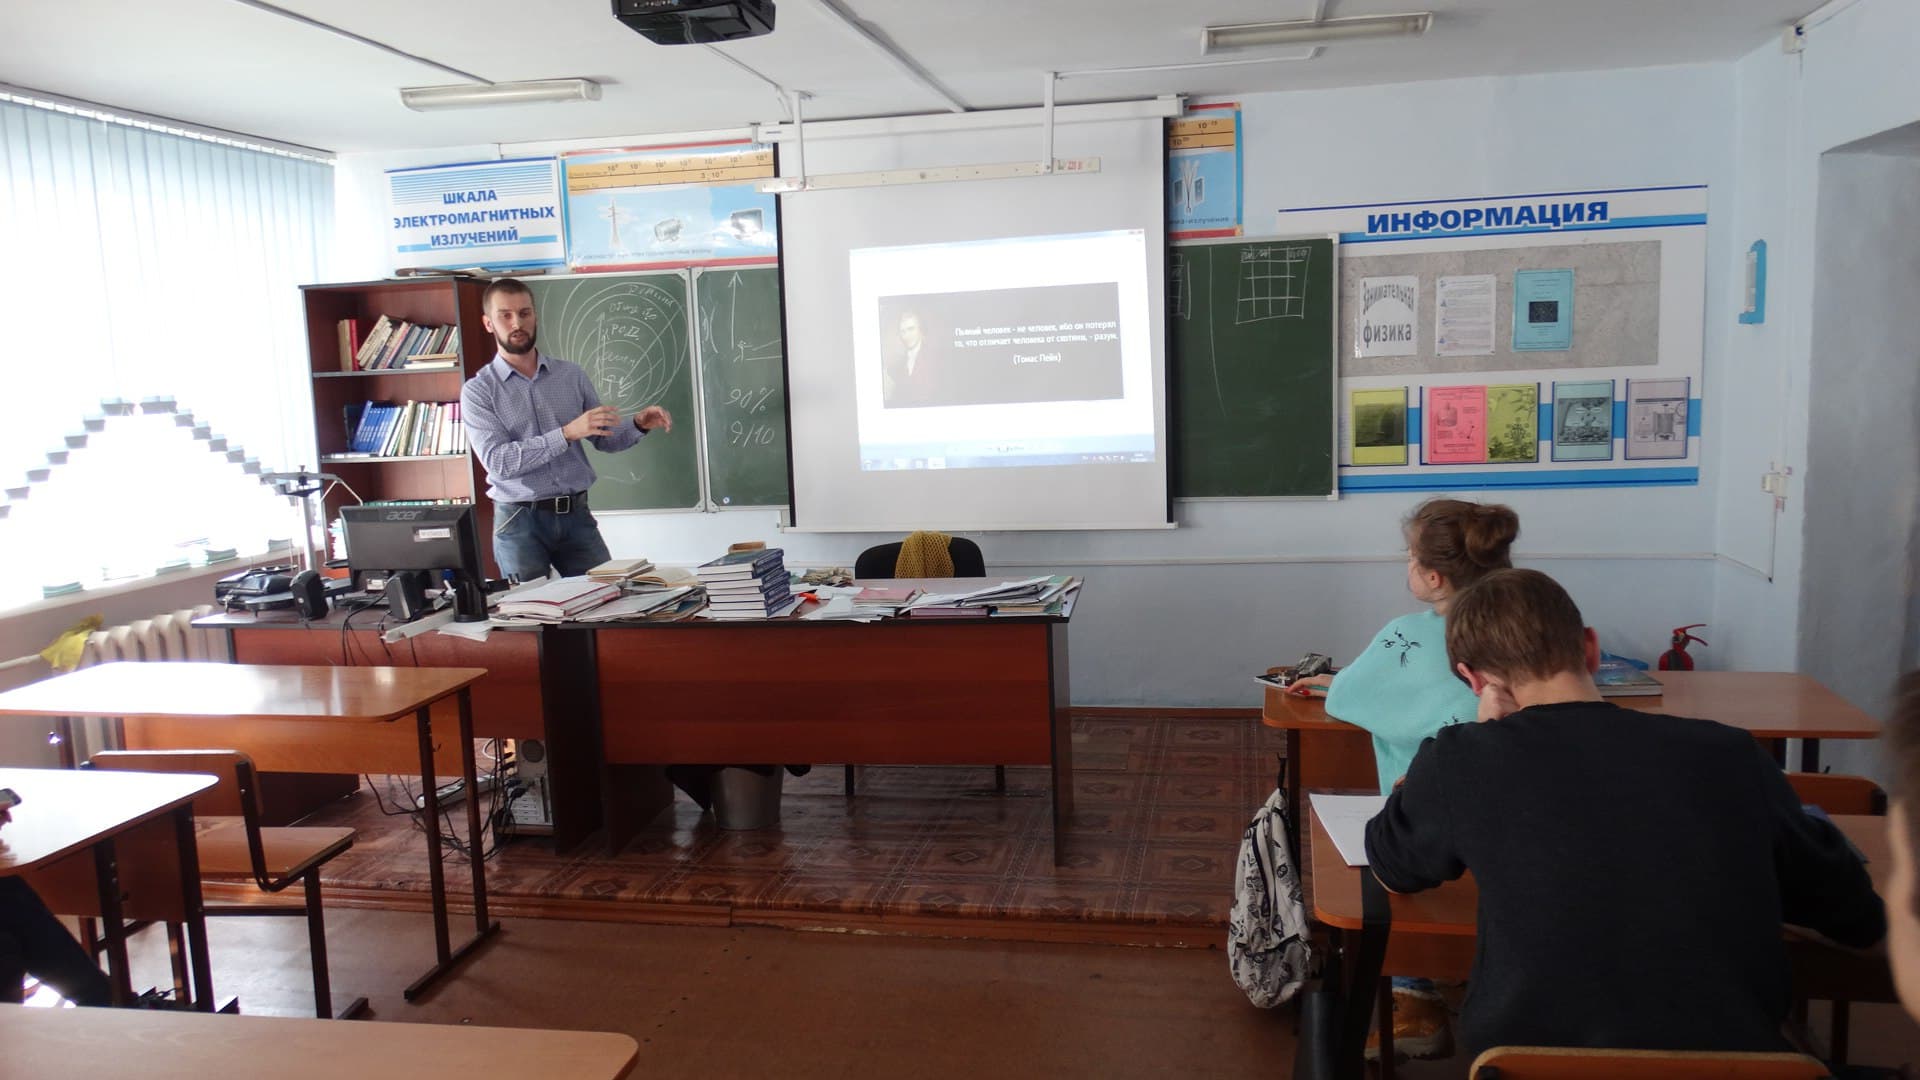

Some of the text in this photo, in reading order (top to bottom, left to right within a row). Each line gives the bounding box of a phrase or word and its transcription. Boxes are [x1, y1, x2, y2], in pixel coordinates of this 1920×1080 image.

[443, 189, 498, 204] ШКАЛА
[393, 206, 556, 229] ЭЛЕКТРОМАГНИТНЫХ
[1367, 201, 1608, 233] ИНФОРМАЦИЯ
[431, 226, 519, 246] ИЗЛУЧЕНИЙ
[1085, 320, 1117, 331] потерял
[1363, 320, 1412, 348] физика
[1046, 335, 1055, 343] от
[386, 510, 421, 521] acer
